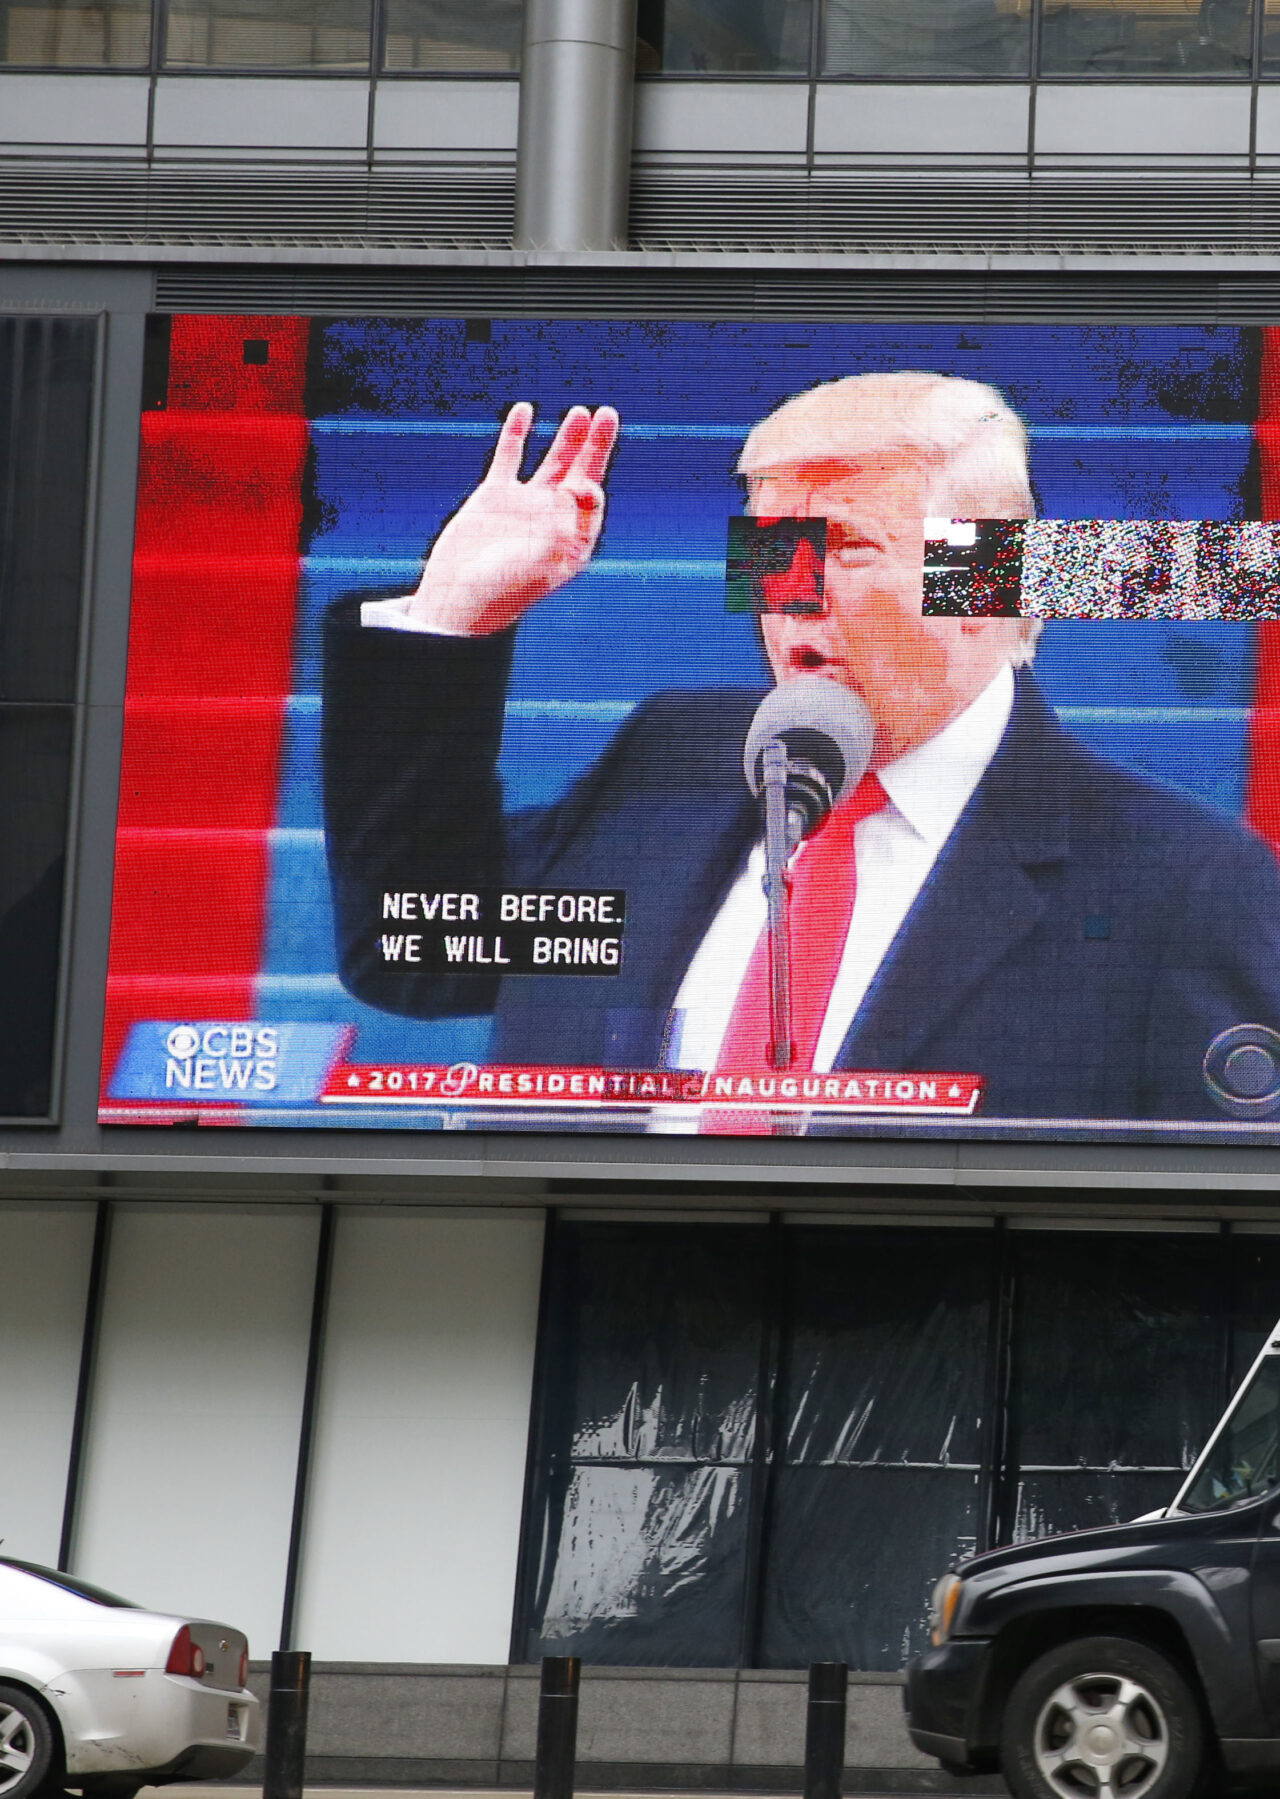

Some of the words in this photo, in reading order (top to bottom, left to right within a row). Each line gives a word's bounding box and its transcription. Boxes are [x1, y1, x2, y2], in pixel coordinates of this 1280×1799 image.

[382, 892, 480, 921] NEVER
[500, 894, 624, 923] BEFORE.
[380, 934, 423, 962] WE
[444, 935, 511, 964] WILL
[533, 936, 619, 965] BRING
[202, 1027, 278, 1058] CBS
[166, 1058, 277, 1090] NEWS
[368, 1070, 436, 1091] 2017
[440, 1062, 673, 1096] PRESIDENTIAL
